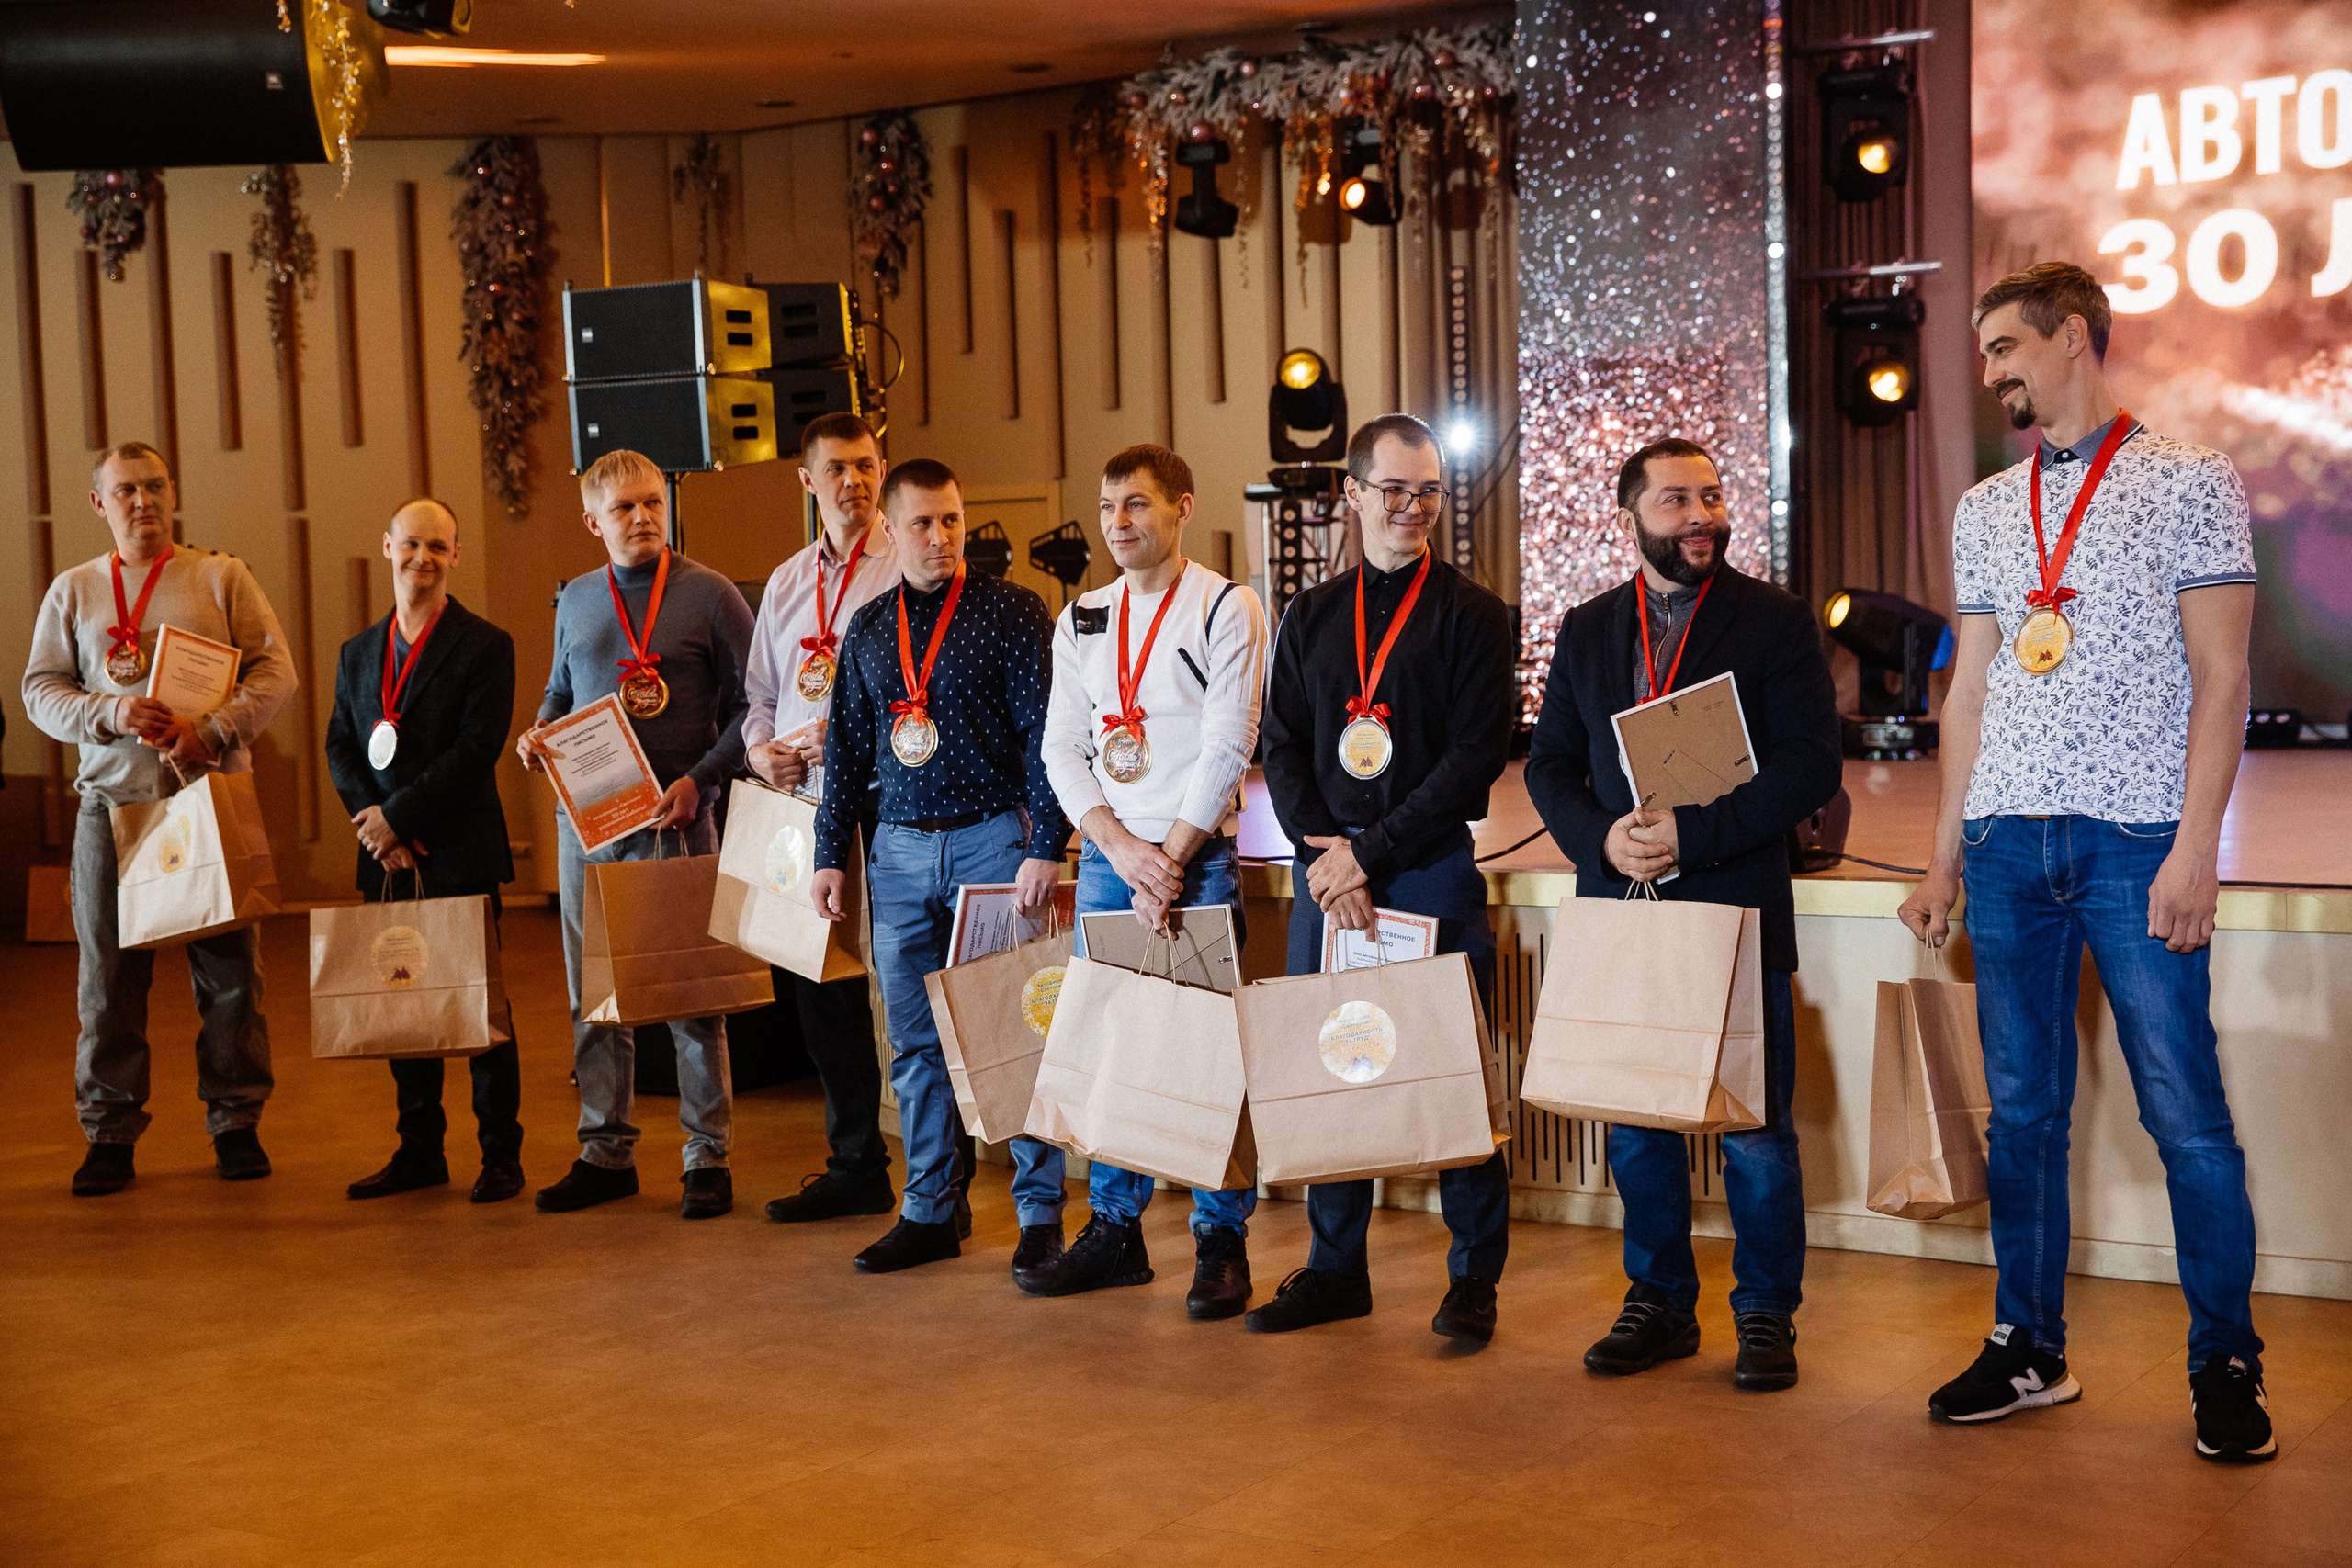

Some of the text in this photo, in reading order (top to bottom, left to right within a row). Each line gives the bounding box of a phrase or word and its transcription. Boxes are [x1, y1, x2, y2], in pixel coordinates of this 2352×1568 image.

[2116, 69, 2352, 191] АВТО
[2098, 208, 2278, 314] 30
[967, 903, 982, 961] ЛАГОДАРСТВЕННОЕ
[977, 922, 986, 949] ПИСЬМО
[1031, 993, 1060, 1003] БЛАГОДАР
[1330, 1027, 1384, 1041] БЛАГОДАРНОСТЬ
